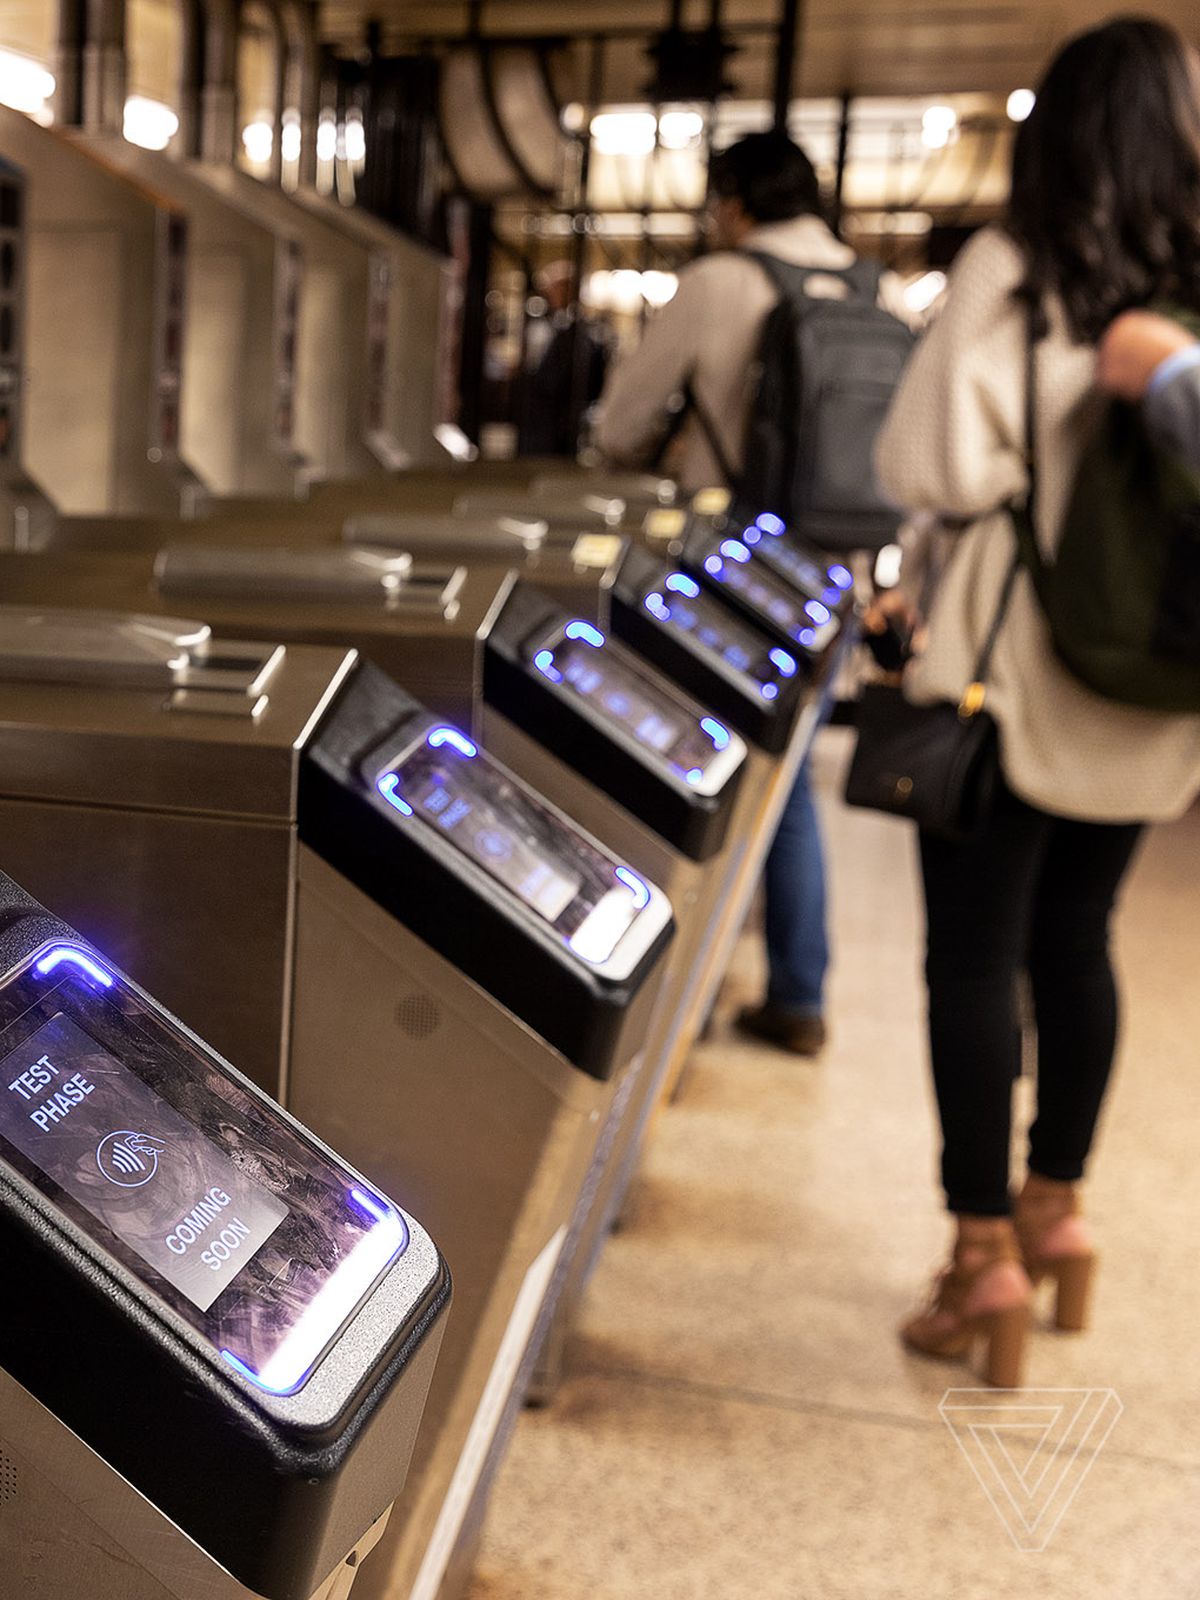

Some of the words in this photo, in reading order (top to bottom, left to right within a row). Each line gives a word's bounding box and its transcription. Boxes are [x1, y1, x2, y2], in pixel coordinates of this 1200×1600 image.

[8, 1054, 60, 1100] TEST
[29, 1072, 96, 1132] PHASE
[165, 1187, 232, 1255] COMING
[200, 1217, 251, 1271] SOON
